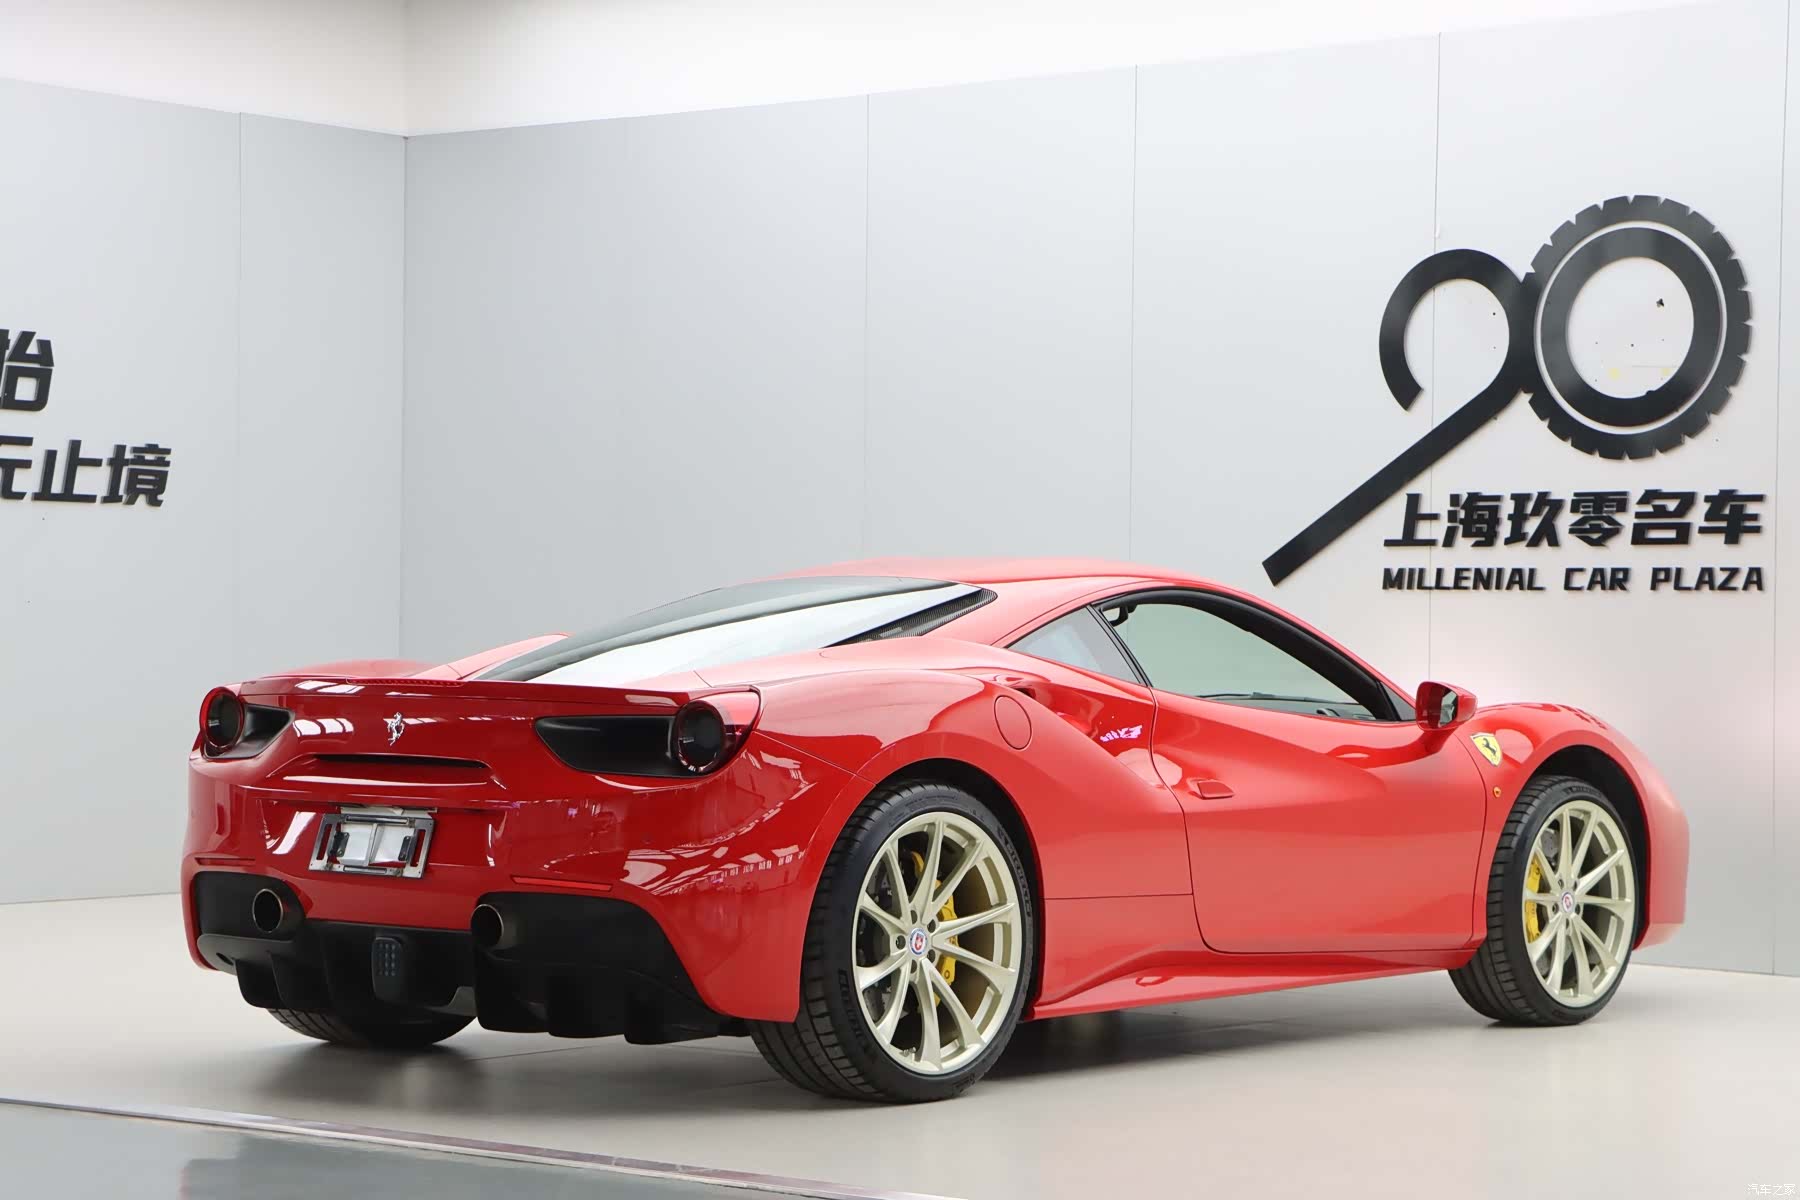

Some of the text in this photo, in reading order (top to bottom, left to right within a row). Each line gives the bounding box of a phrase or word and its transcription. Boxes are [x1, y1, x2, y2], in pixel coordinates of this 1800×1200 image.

[1384, 489, 1765, 547] 上海玖零名车
[1382, 567, 1764, 591] MILLENIAL CAR PLAZA
